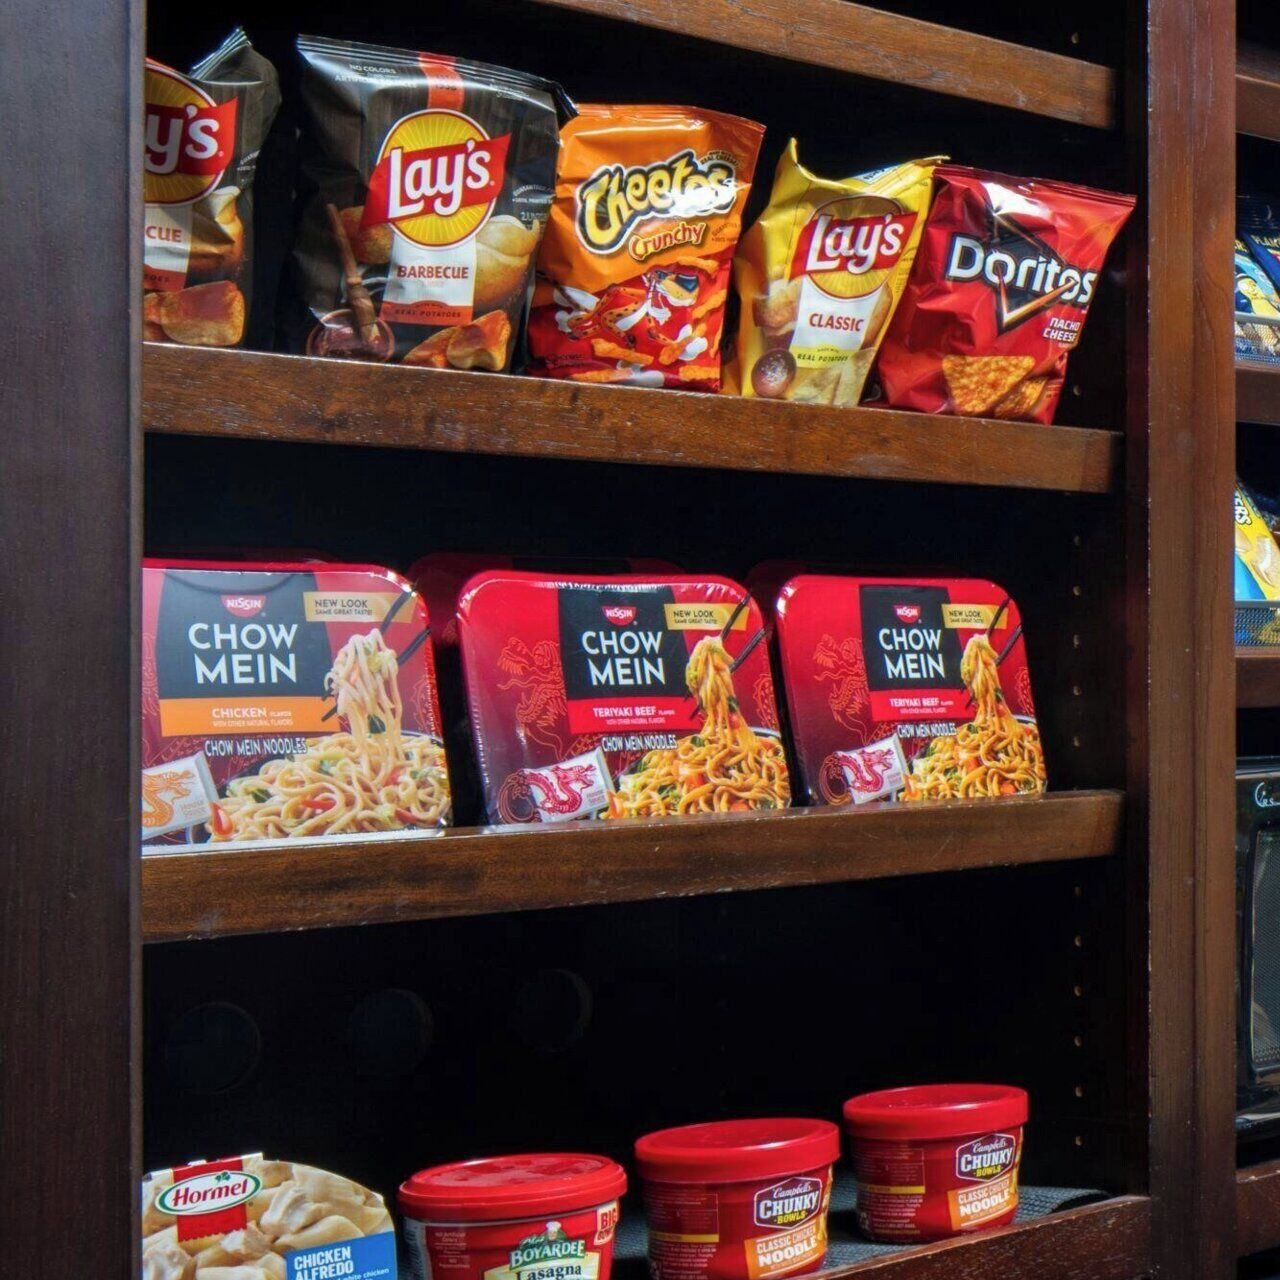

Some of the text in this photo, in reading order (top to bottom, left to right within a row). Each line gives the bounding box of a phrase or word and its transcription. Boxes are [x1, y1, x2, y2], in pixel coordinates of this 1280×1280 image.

[145, 106, 219, 173] y's
[388, 138, 491, 218] Lay's
[581, 153, 736, 247] Cheetos
[629, 221, 706, 260] Crunchy
[805, 212, 904, 274] Lay's
[397, 265, 469, 281] BARBECUE
[947, 236, 1098, 305] Doritos
[809, 312, 864, 332] CLASSIC
[1048, 316, 1081, 331] NACHO
[1043, 327, 1078, 343] CHEESE
[225, 596, 263, 611] NISSIN
[314, 598, 369, 609] NEW LOOK
[605, 607, 635, 620] NISSIN
[673, 609, 714, 619] NEW LOOK
[894, 606, 920, 618] NISSIN
[949, 609, 981, 619] NEW LOOK
[188, 622, 299, 651] CHOW
[581, 630, 663, 656] CHOW
[878, 627, 942, 652] CHOW
[193, 653, 298, 685] MEIN
[588, 656, 667, 686] MEIN
[885, 652, 945, 680] MEIN
[211, 707, 267, 718] CHICKEN
[592, 705, 657, 719] TERIYAKI BEEF
[889, 697, 940, 708] TERIYAKI BEEF
[204, 737, 308, 757] CHOW MEIN NOODLES
[959, 1146, 1014, 1175] CHUNKY
[974, 1164, 1002, 1179] BOWLS
[170, 1177, 249, 1208] Hormel
[758, 1189, 820, 1219] CHUNKY
[957, 1184, 989, 1206] CLASSIC
[958, 1189, 1012, 1218] NOODLE
[600, 1207, 618, 1230] BIG
[775, 1210, 807, 1225] BOWLS
[756, 1231, 791, 1252] CLASSIC
[757, 1236, 819, 1268] NOODLE
[293, 1246, 352, 1271] CHICKEN
[510, 1240, 586, 1270] BOYARDEE
[363, 1267, 390, 1279] chicken
